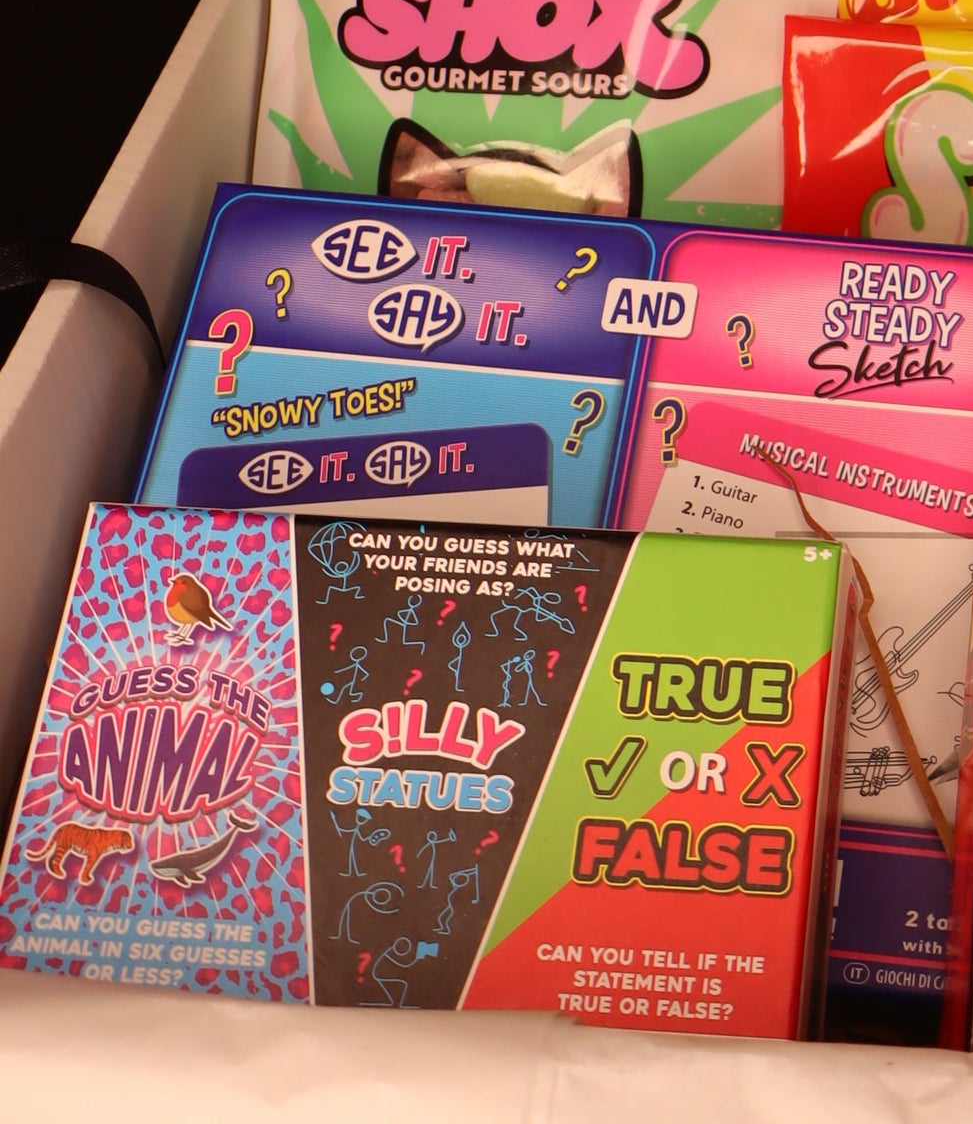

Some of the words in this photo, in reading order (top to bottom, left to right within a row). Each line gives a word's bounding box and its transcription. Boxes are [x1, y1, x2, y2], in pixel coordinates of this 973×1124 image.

[384, 66, 526, 91] GOURMET
[531, 70, 630, 96] SOURS
[322, 226, 403, 274] SEE
[421, 235, 474, 280] IT.
[838, 260, 956, 307] READY
[373, 287, 456, 342] SAY
[475, 301, 527, 347] IT.
[611, 287, 686, 328] AND
[824, 299, 963, 350] STEADY
[808, 339, 954, 398] Sketch
[247, 454, 304, 491] SEE
[319, 451, 356, 484] IT.
[369, 445, 427, 480] SAY
[438, 442, 475, 475] IT.
[739, 433, 829, 477] MUSICAL
[692, 475, 704, 490] 1.
[711, 480, 758, 504] Guitar
[681, 501, 695, 516] 2.
[701, 505, 744, 529] Piano
[349, 532, 390, 550] CAN
[398, 534, 438, 551] YOU
[443, 536, 509, 555] GUESS
[516, 539, 575, 559] WHAT
[802, 545, 833, 563] 5+
[364, 553, 417, 571] YOUR
[422, 556, 507, 575] FRIENDS
[512, 561, 553, 578] ARE
[394, 576, 471, 595] POSING
[475, 580, 515, 598] AS?
[70, 665, 199, 719] GUESS
[208, 671, 272, 733] THE
[611, 652, 797, 725] TRUE
[61, 705, 261, 818] ANIMAL
[659, 749, 727, 793] OR
[326, 765, 515, 814] STATUES
[572, 816, 795, 896] FALSE
[34, 913, 81, 932] CAN
[87, 915, 129, 934] YOU
[136, 920, 206, 939] GUESS
[213, 923, 253, 942] THE
[904, 910, 919, 928] 2
[9, 936, 92, 957] ANIMAL
[100, 942, 122, 958] IN
[128, 942, 165, 961] SIX
[170, 947, 267, 967] GUESSES
[536, 944, 583, 963] CAN
[590, 946, 634, 966] YOU
[641, 949, 691, 970] TELL
[697, 953, 717, 970] IF
[724, 954, 766, 974] THE
[902, 939, 943, 955] with
[84, 963, 114, 982] OR
[120, 965, 184, 986] LESS?
[573, 969, 696, 993] STATEMENT
[702, 977, 722, 996] IS
[850, 967, 864, 980] IT
[875, 968, 916, 987] GIOCHI
[918, 973, 931, 989] DI
[557, 992, 612, 1014] TRUE
[619, 996, 650, 1016] OR
[655, 998, 735, 1021] FALSE?
